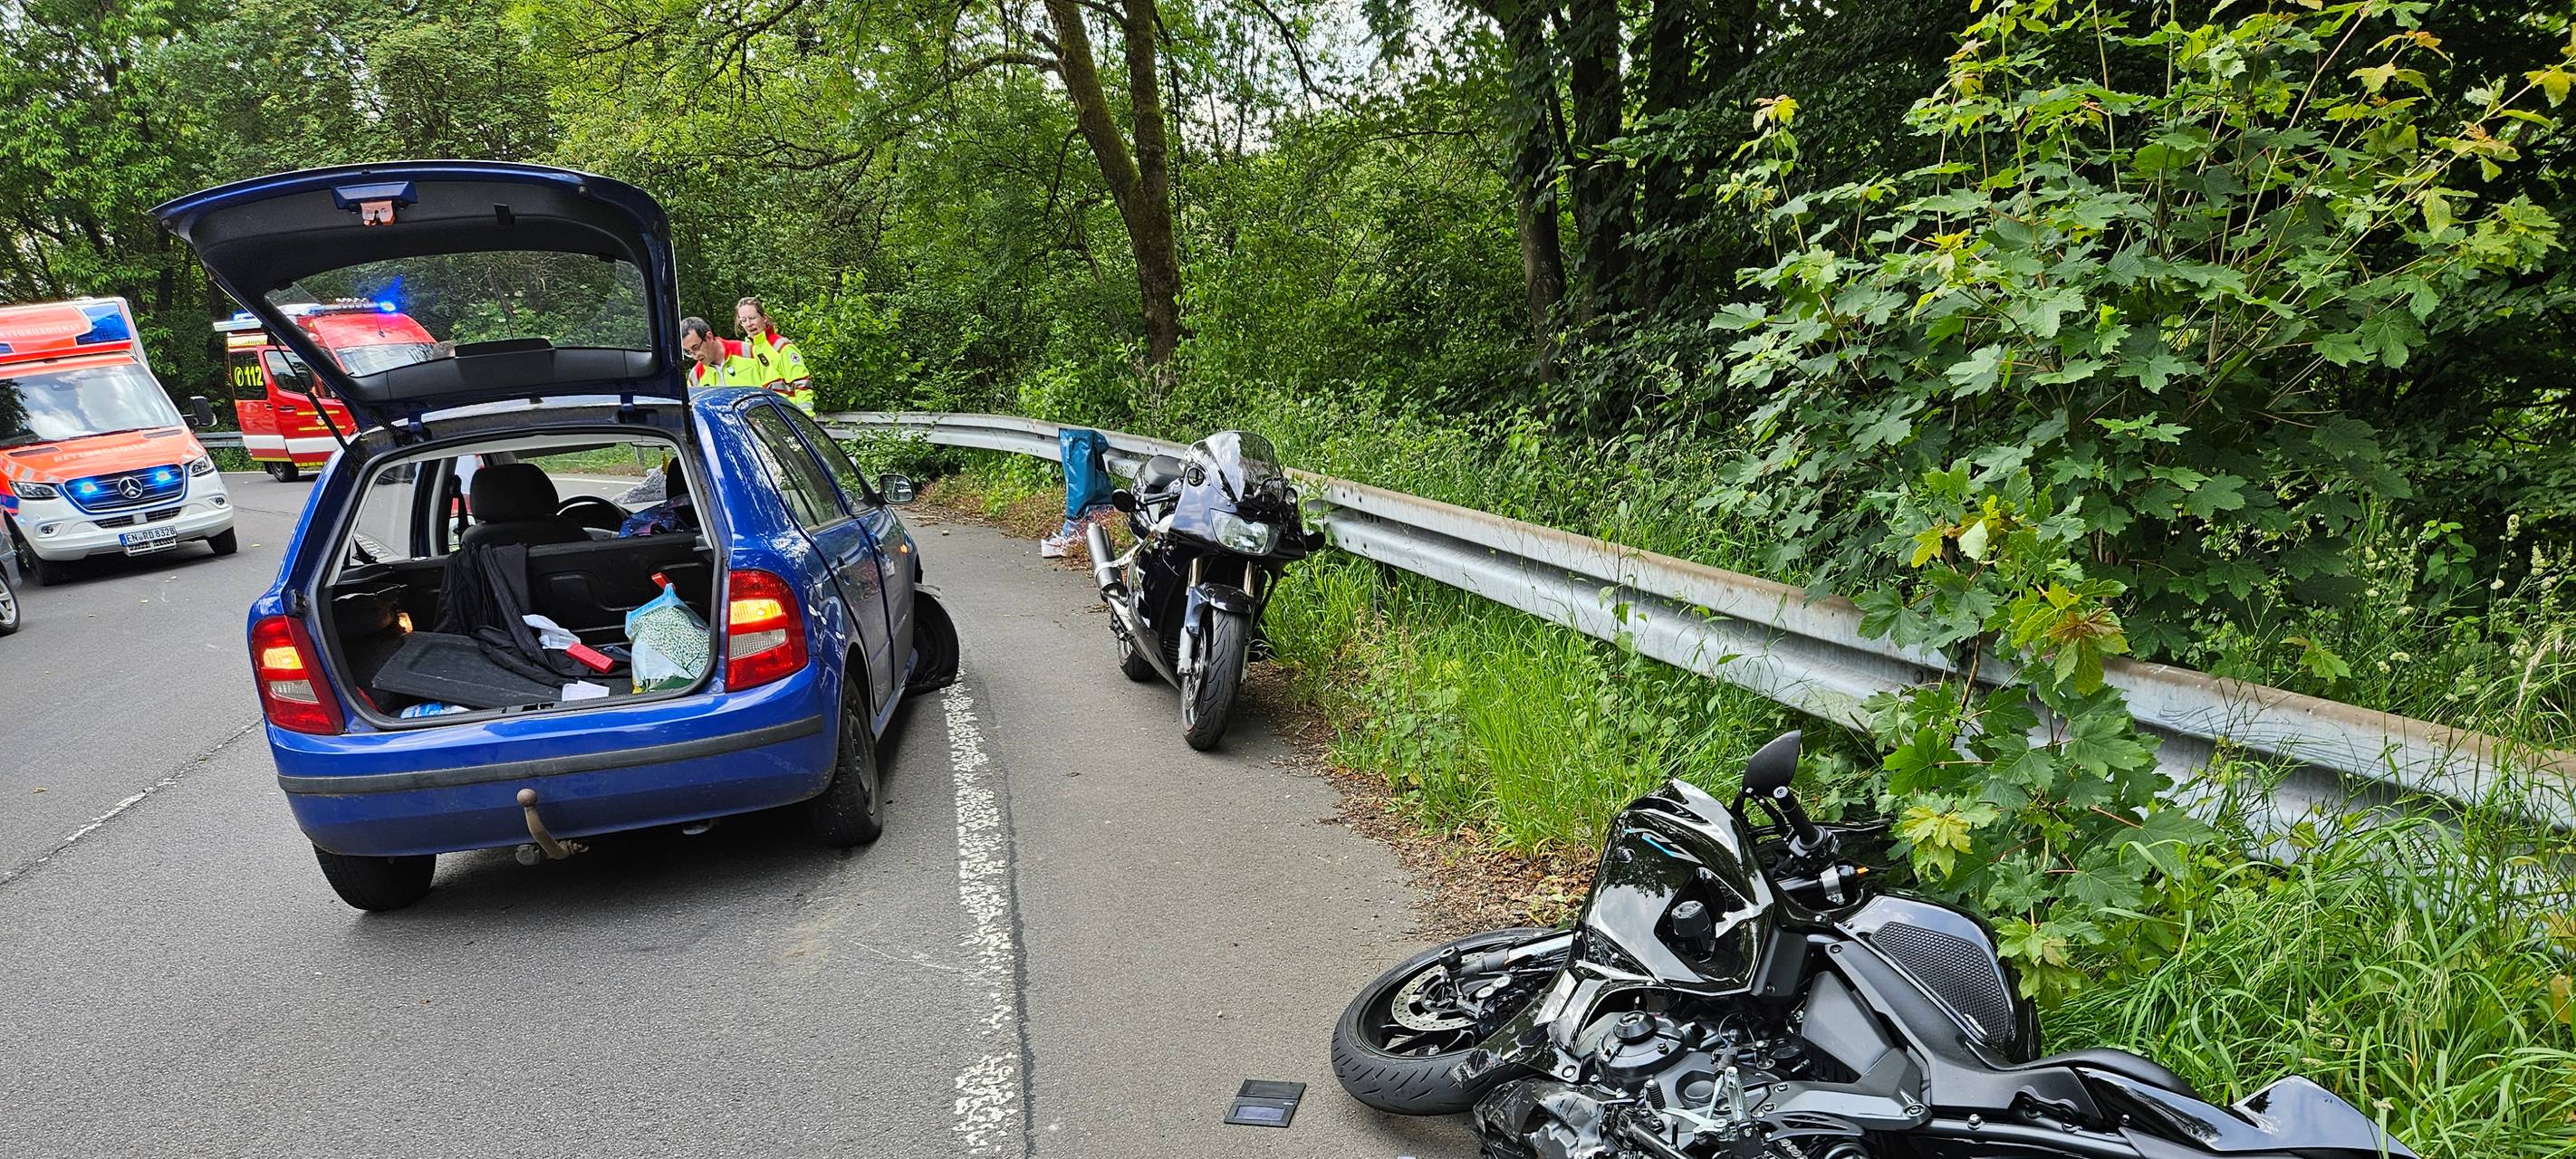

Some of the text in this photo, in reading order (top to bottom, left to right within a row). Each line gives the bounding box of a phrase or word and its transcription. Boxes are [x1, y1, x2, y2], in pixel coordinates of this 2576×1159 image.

[245, 366, 264, 387] 112
[127, 527, 176, 543] EN RD 8328
